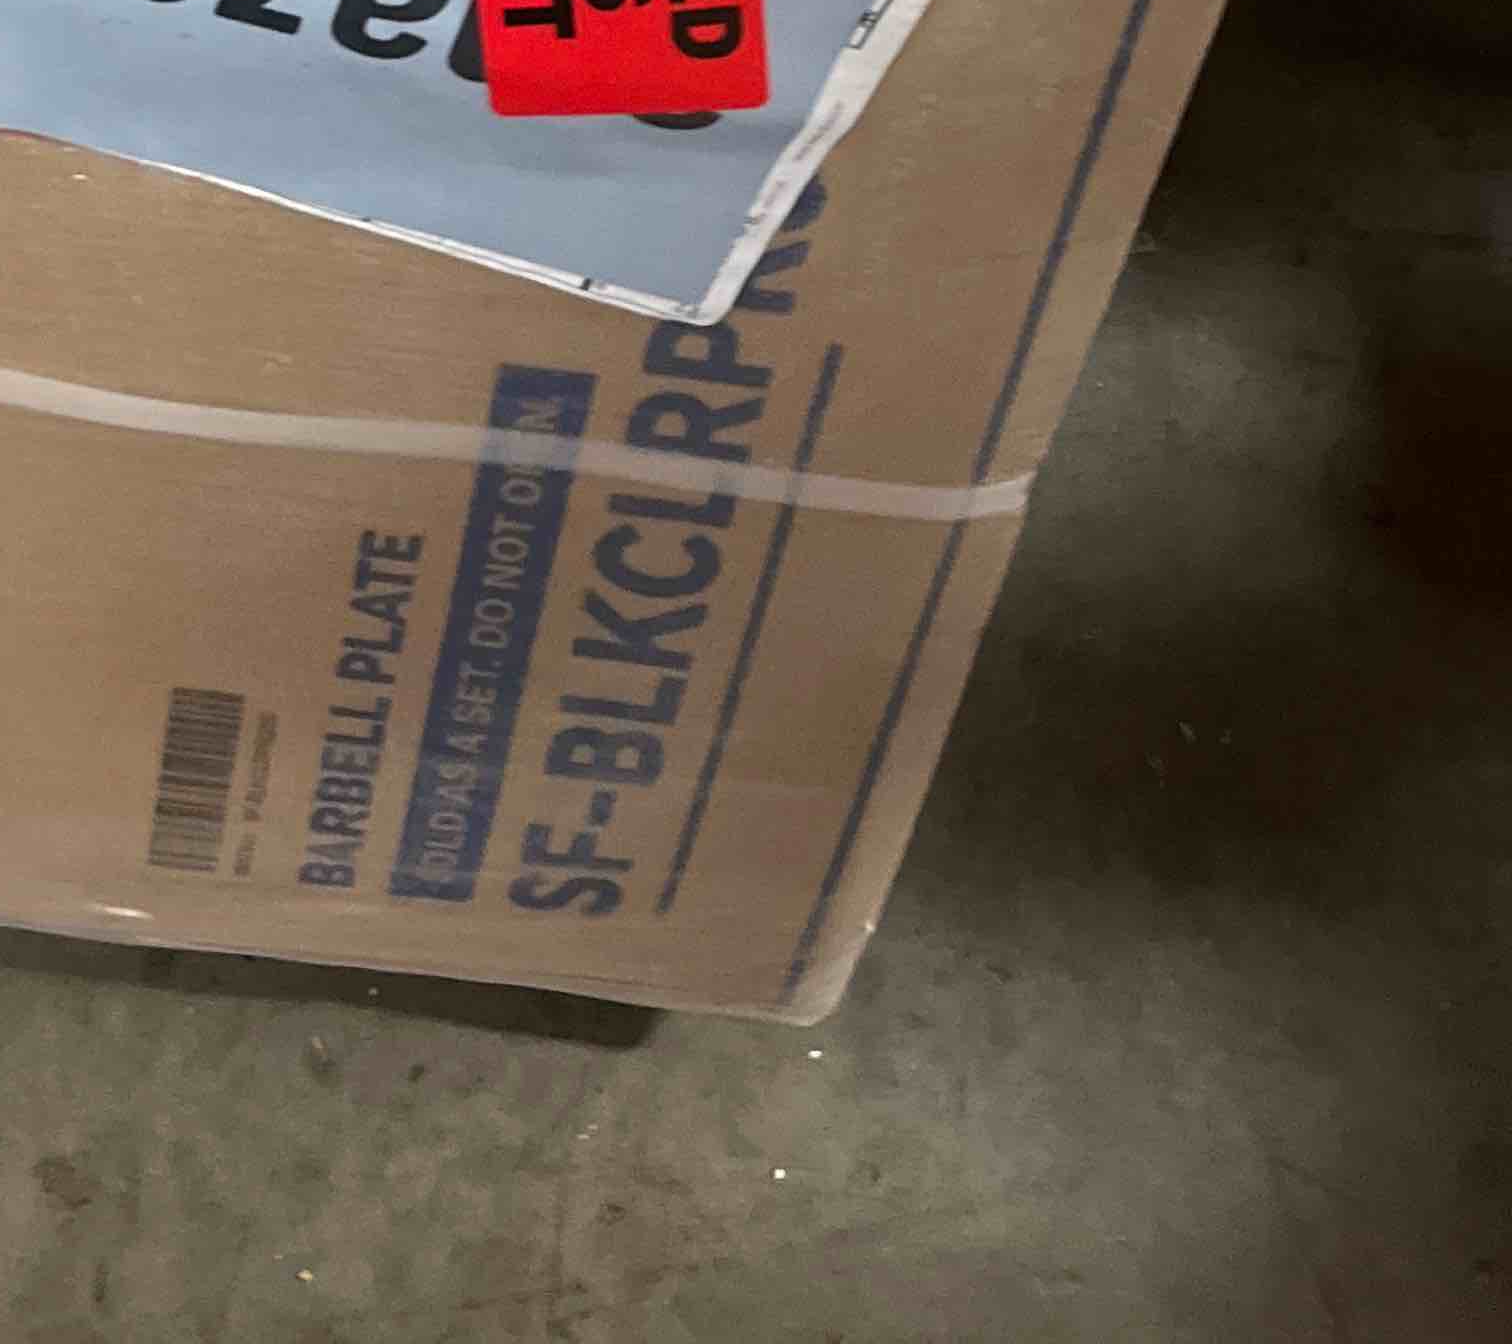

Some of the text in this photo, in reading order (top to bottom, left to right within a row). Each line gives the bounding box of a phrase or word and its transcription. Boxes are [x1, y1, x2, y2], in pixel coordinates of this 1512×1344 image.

[486, 514, 536, 591] NOT
[471, 598, 515, 648] DO
[299, 529, 423, 889] BARBELL PLATE
